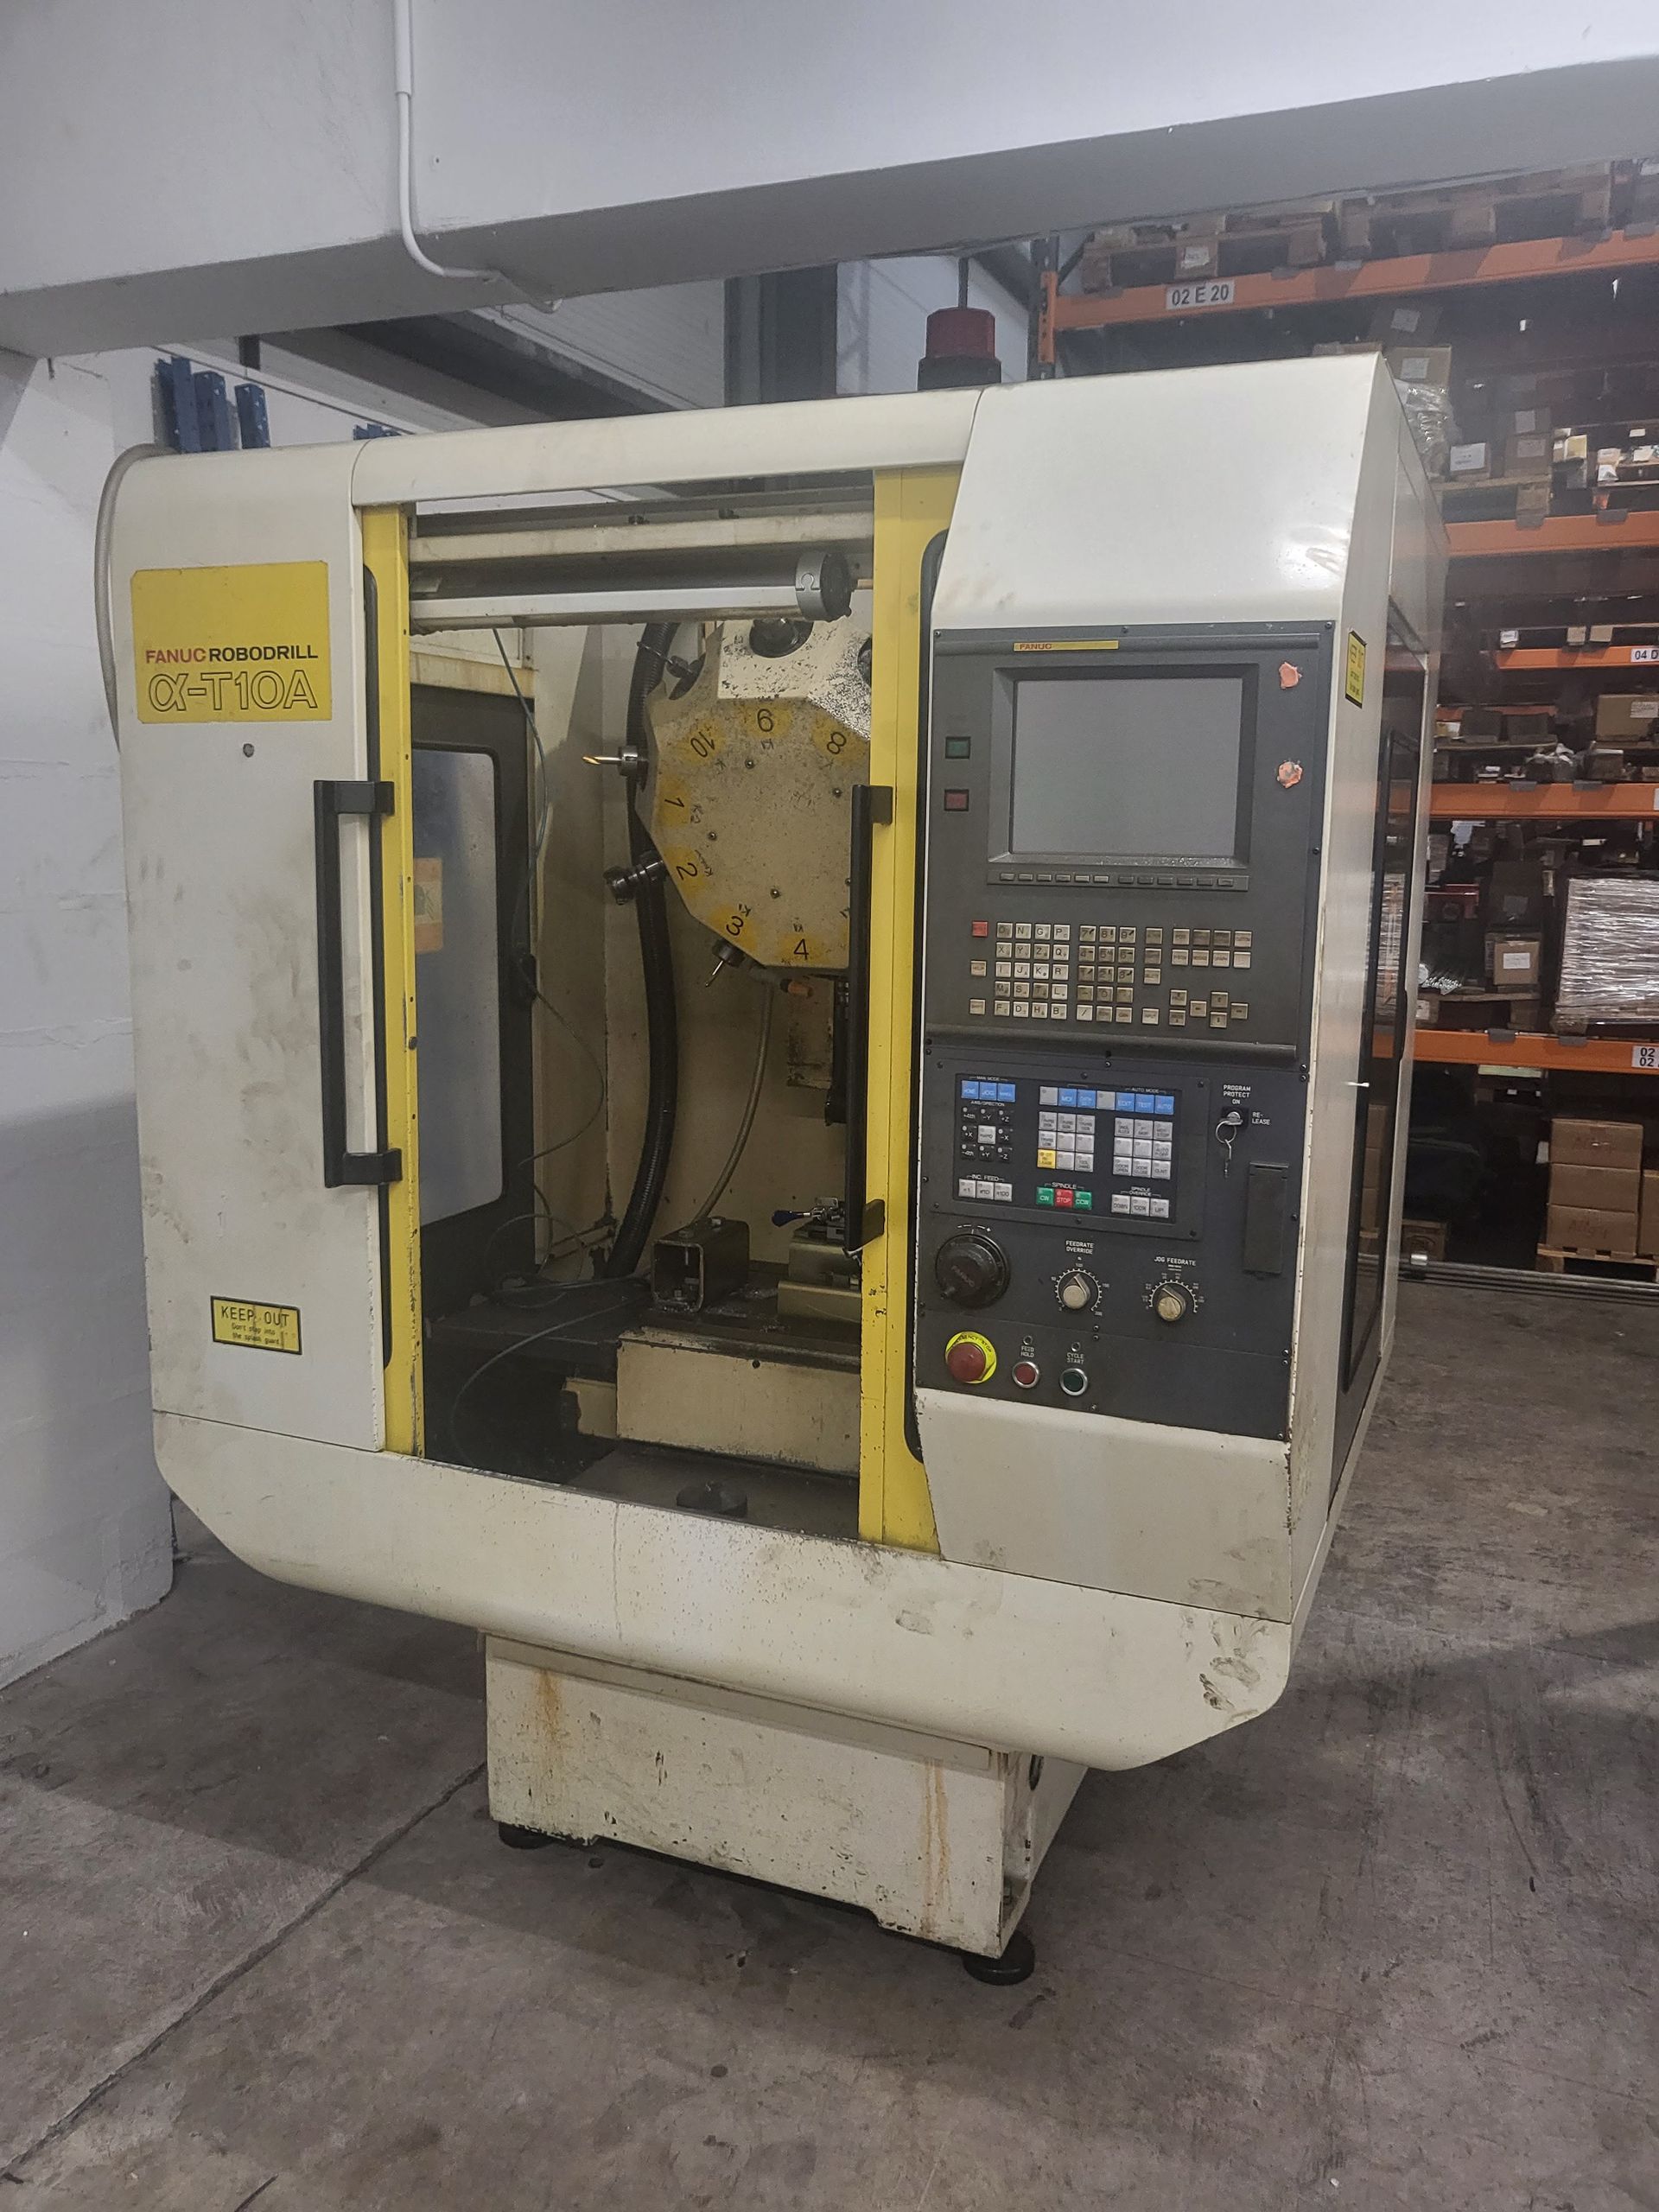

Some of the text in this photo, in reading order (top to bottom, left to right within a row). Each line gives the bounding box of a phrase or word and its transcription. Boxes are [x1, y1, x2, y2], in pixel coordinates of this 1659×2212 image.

[1172, 283, 1230, 306] 02 E 20
[145, 645, 319, 664] FANUC ROBODRILL
[1634, 650, 1659, 660] 04 D
[690, 731, 715, 759] 10
[826, 732, 847, 755] 8
[663, 796, 685, 810] 1
[675, 861, 698, 880] 2
[726, 915, 745, 937] 3
[793, 938, 810, 961] 4
[1016, 946, 1023, 955] Y
[1055, 948, 1062, 957] Q
[996, 1003, 1002, 1012] F
[1640, 1047, 1656, 1058] 02
[1639, 1057, 1655, 1067] 02
[1117, 1099, 1133, 1108] EDIT
[1052, 1181, 1077, 1190] SPINDLE
[1065, 1240, 1094, 1249] FEEDRATE
[1065, 1246, 1094, 1255] OVERRIDE
[1166, 1257, 1197, 1267] FEEDRATE
[221, 1306, 289, 1326] KEEP OUT
